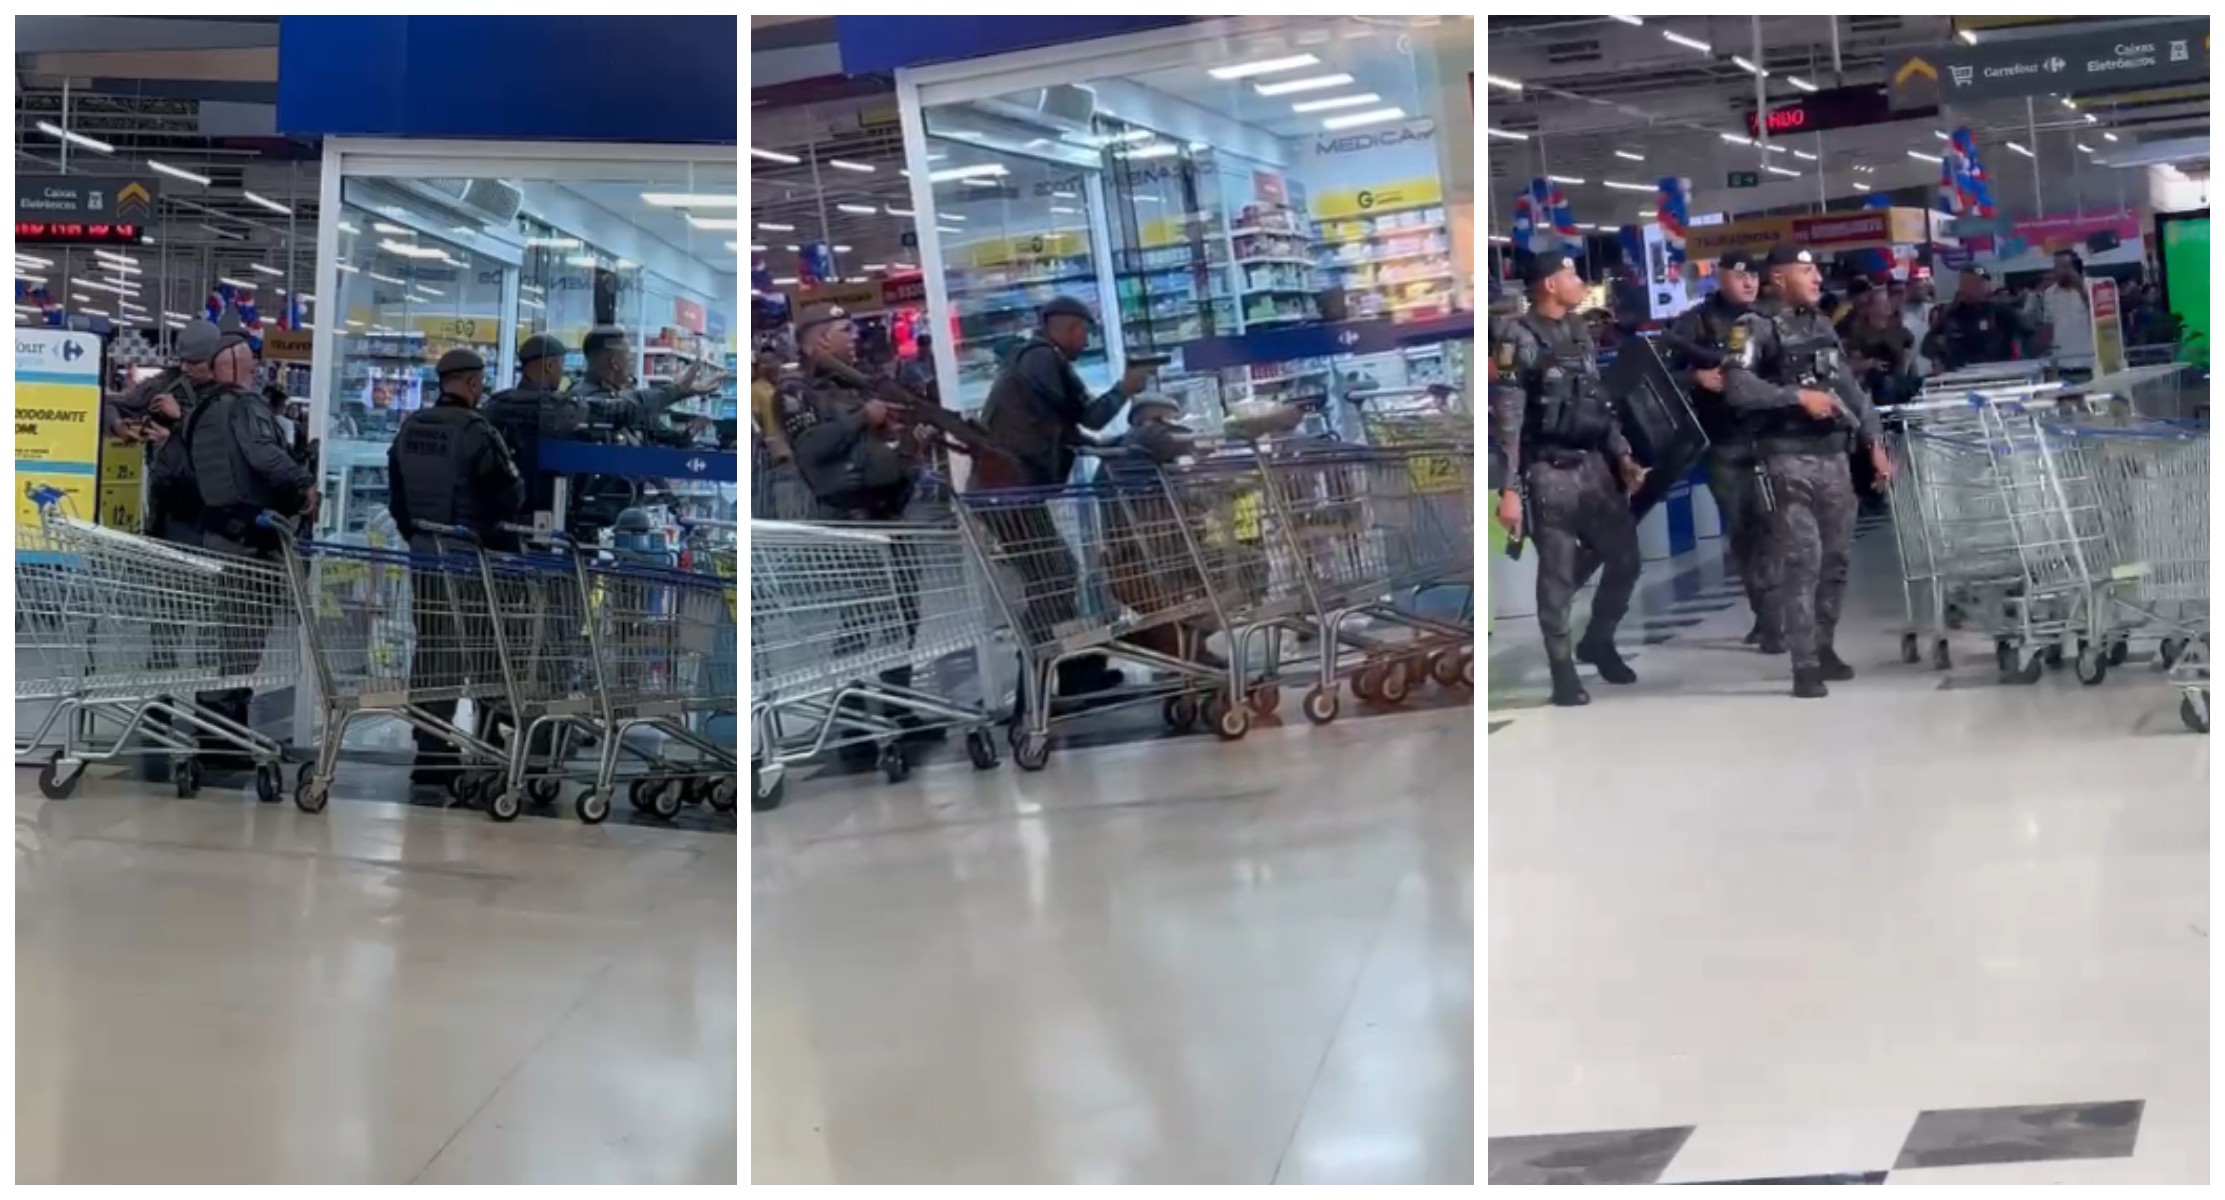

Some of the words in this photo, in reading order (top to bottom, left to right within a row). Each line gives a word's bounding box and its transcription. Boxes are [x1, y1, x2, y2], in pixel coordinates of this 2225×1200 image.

[2114, 42, 2155, 56] Caixas
[1983, 62, 2040, 78] Carrefour
[43, 187, 77, 198] Caixas
